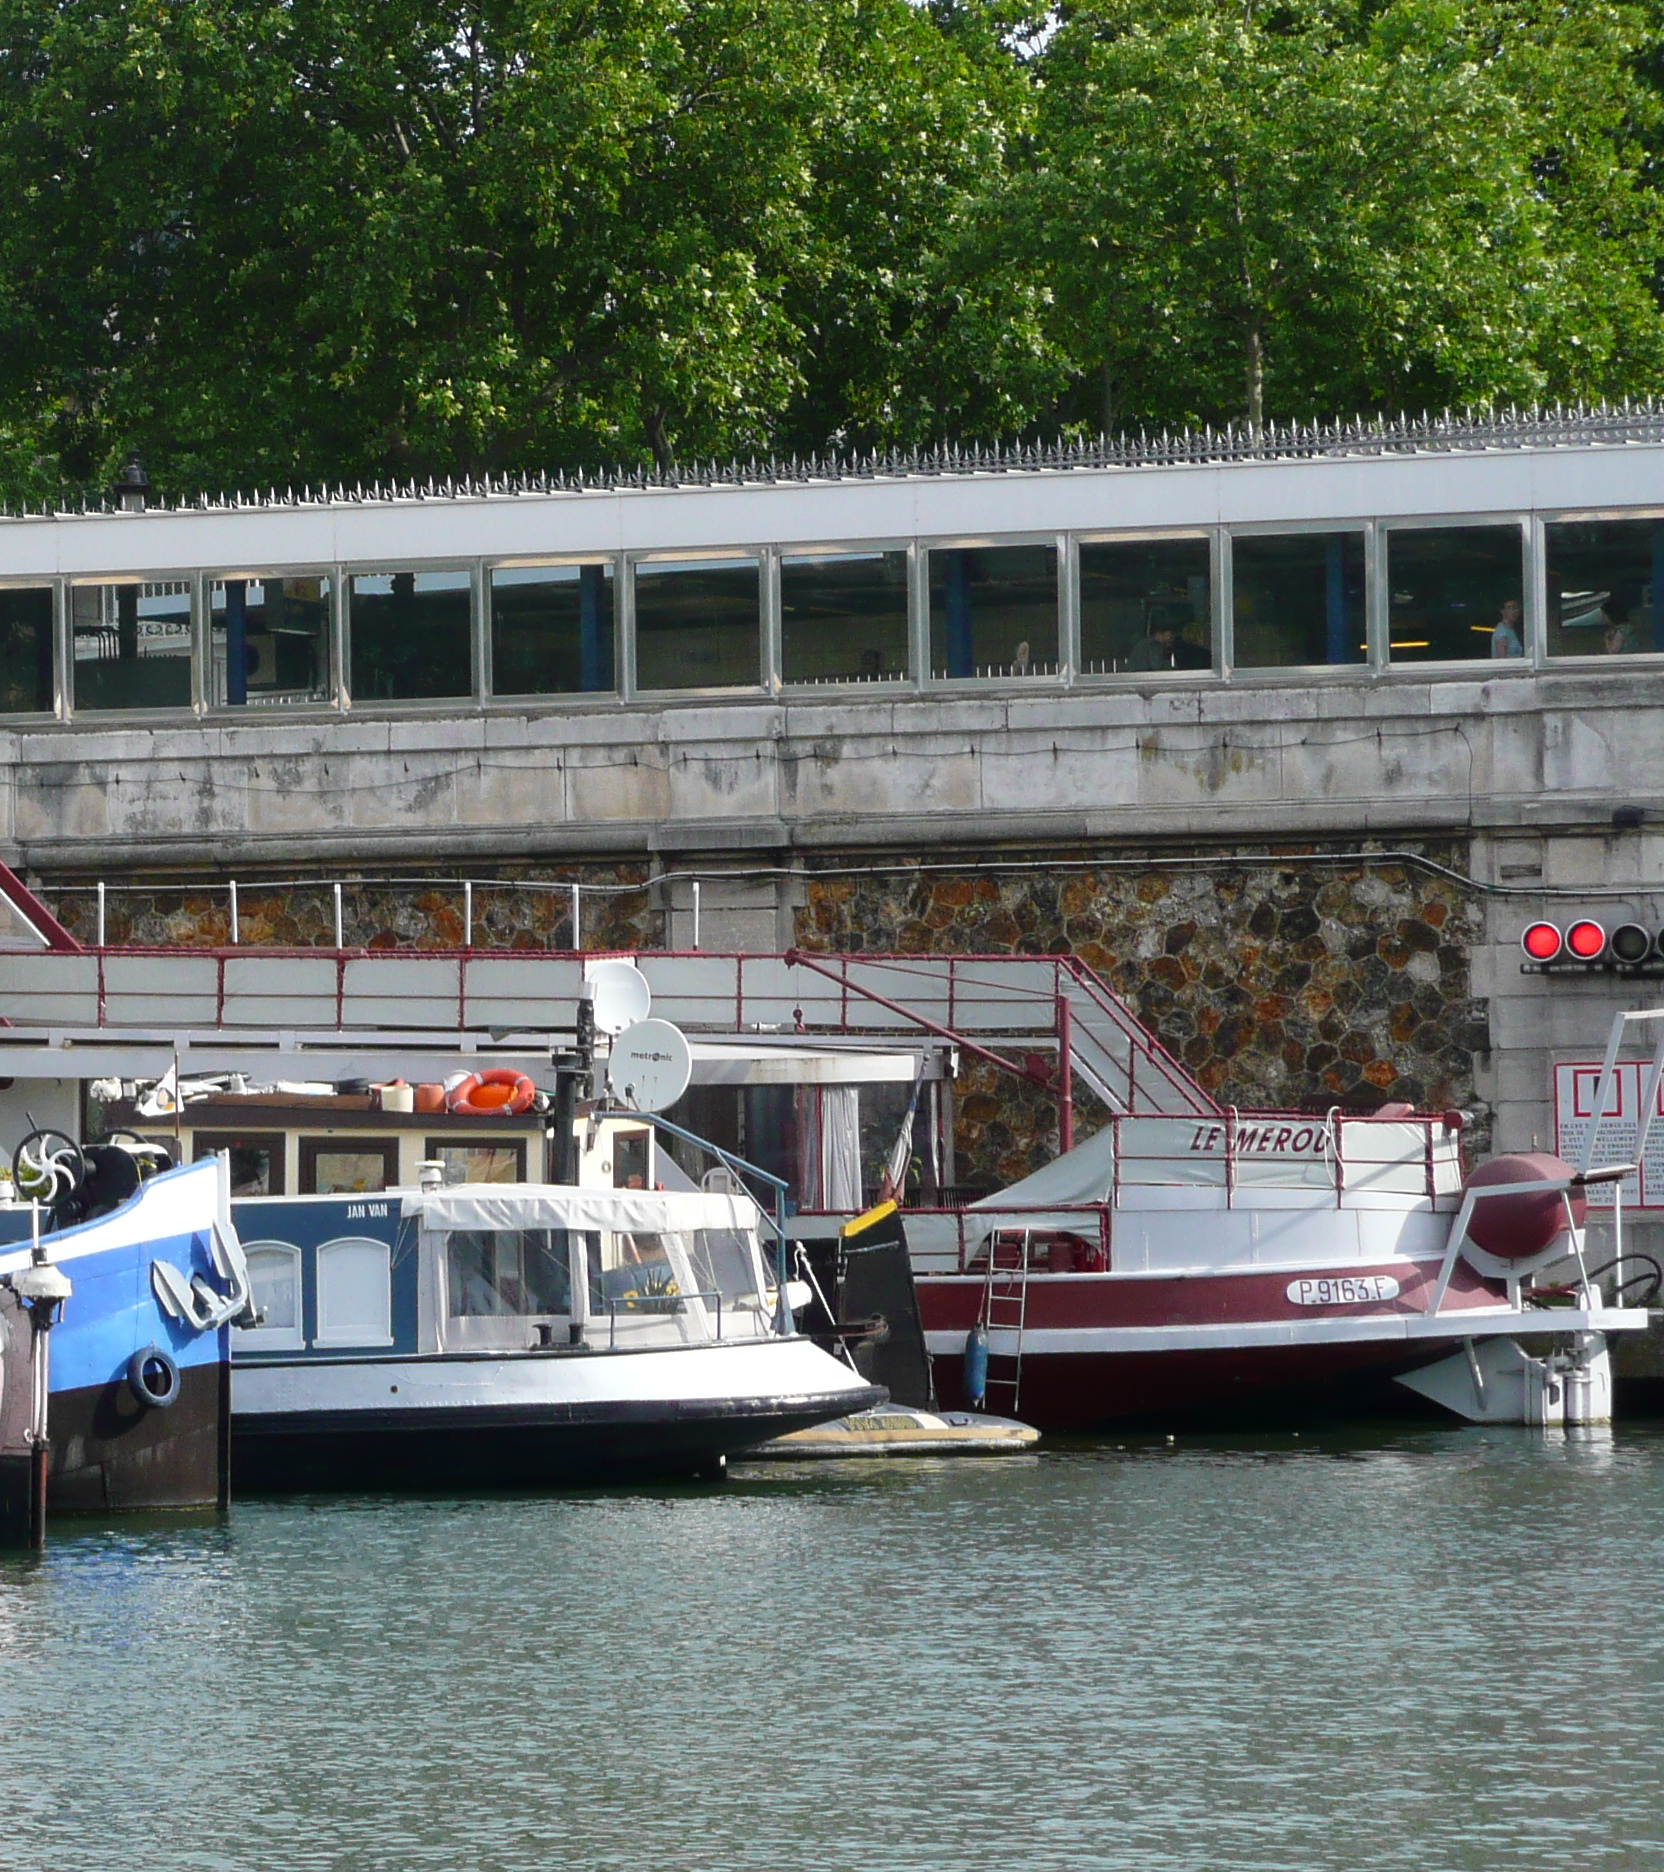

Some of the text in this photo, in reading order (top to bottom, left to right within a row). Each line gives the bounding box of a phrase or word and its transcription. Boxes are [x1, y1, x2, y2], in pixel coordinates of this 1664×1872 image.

[630, 1051, 673, 1062] metronic
[1190, 1126, 1331, 1153] LE MEROU
[346, 1202, 388, 1219] JAN VAN
